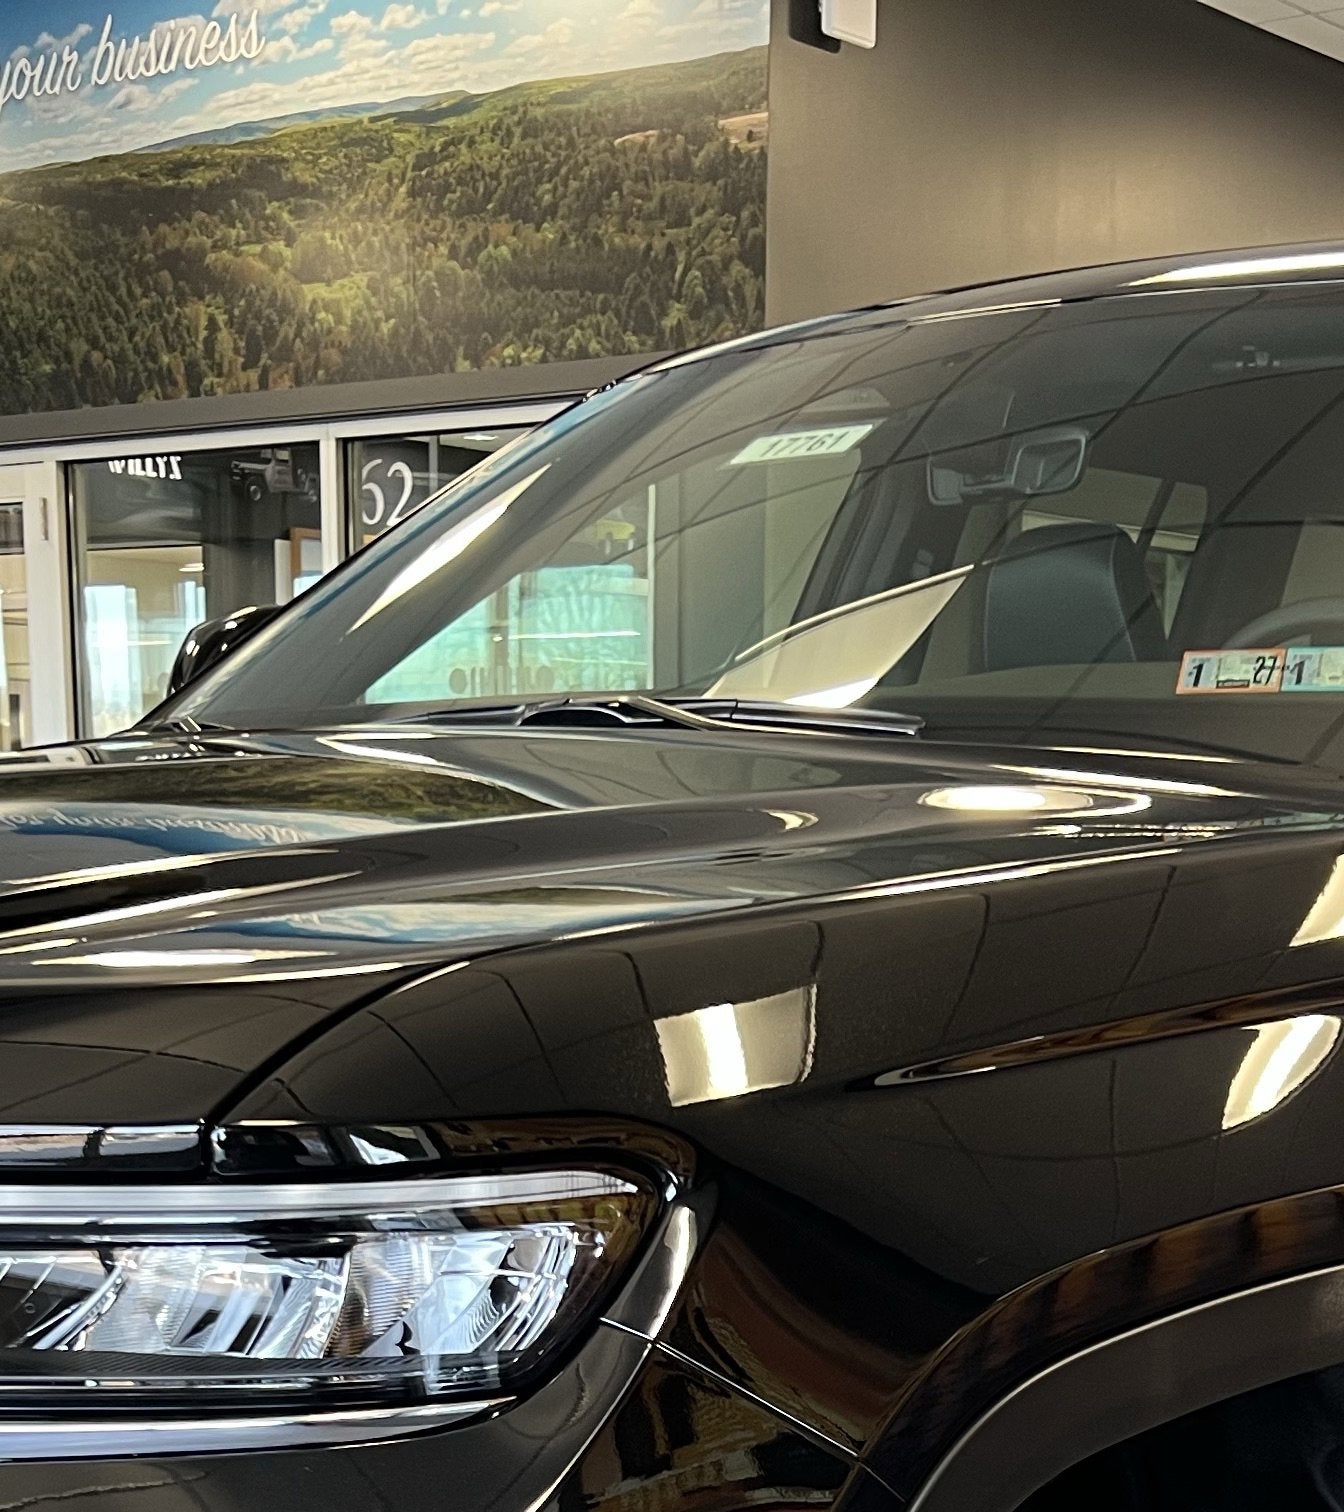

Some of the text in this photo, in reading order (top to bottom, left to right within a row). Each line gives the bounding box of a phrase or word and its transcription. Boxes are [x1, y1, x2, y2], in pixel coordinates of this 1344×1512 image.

[90, 8, 267, 86] business
[759, 430, 850, 458] 17761
[108, 455, 182, 480] WILLYS
[1253, 655, 1278, 686] 27
